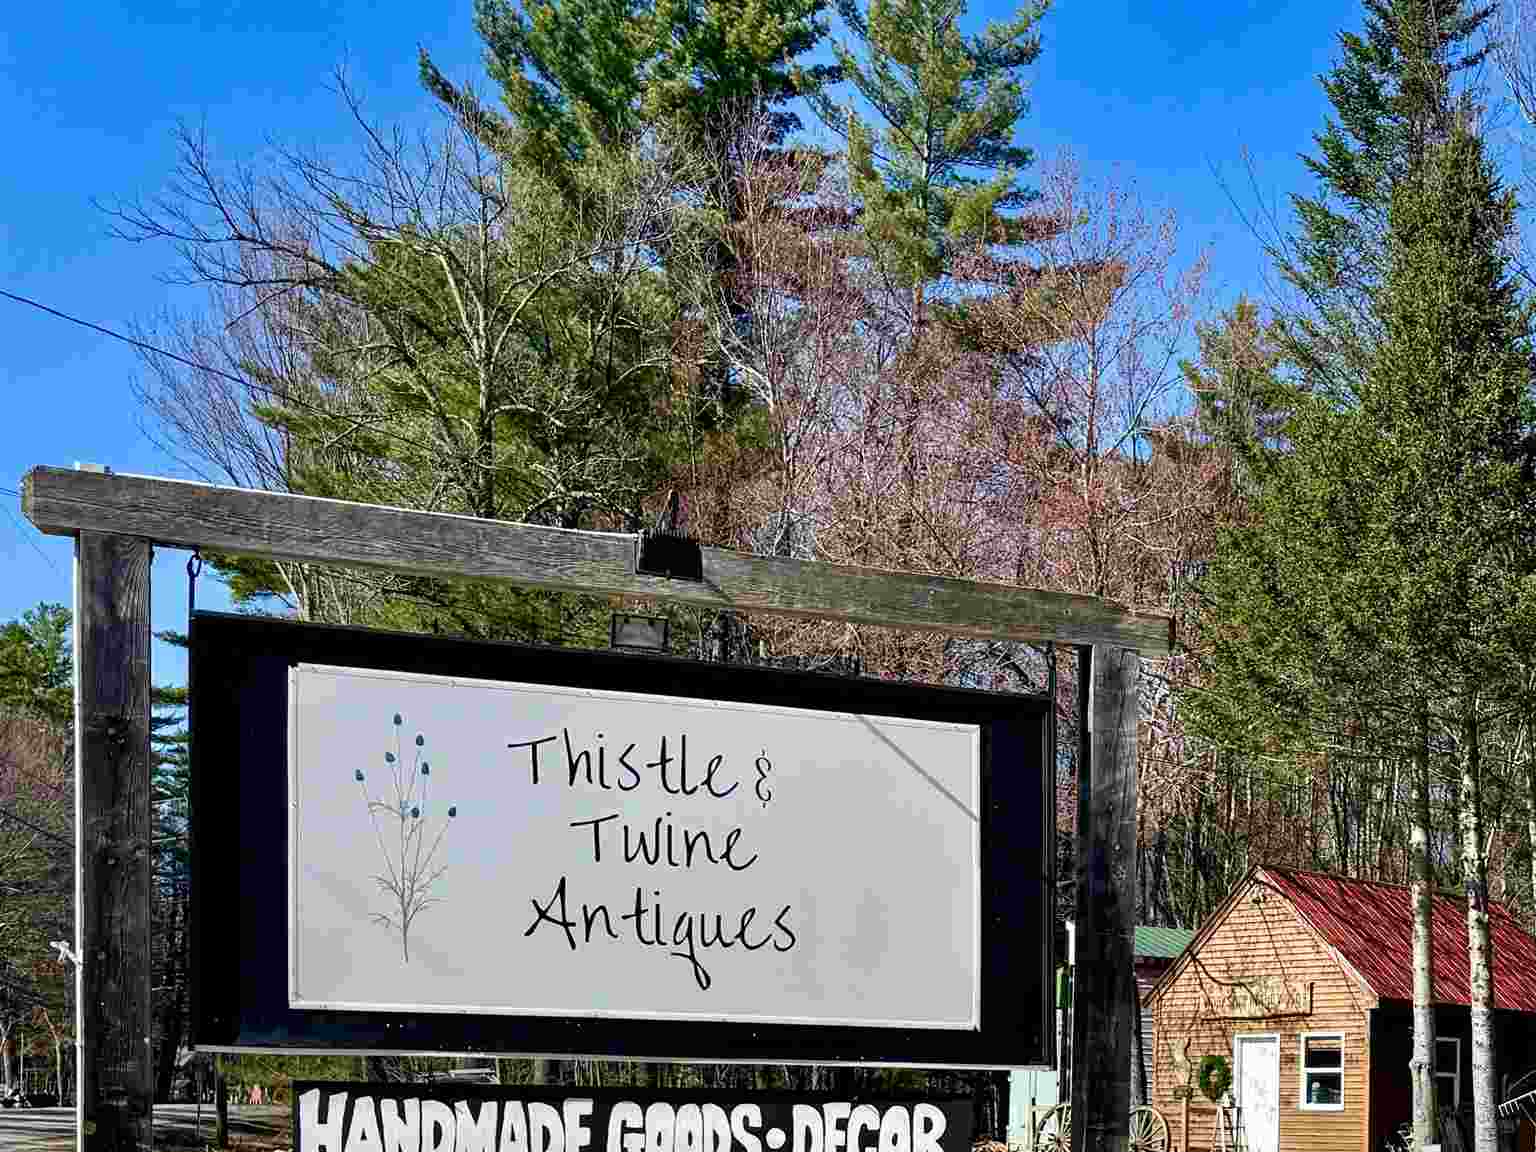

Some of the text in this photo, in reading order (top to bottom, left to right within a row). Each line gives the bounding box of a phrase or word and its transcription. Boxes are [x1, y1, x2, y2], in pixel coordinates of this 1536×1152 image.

[508, 728, 772, 808] Thistle &
[570, 812, 758, 871] Twine
[524, 876, 797, 990] Antiques
